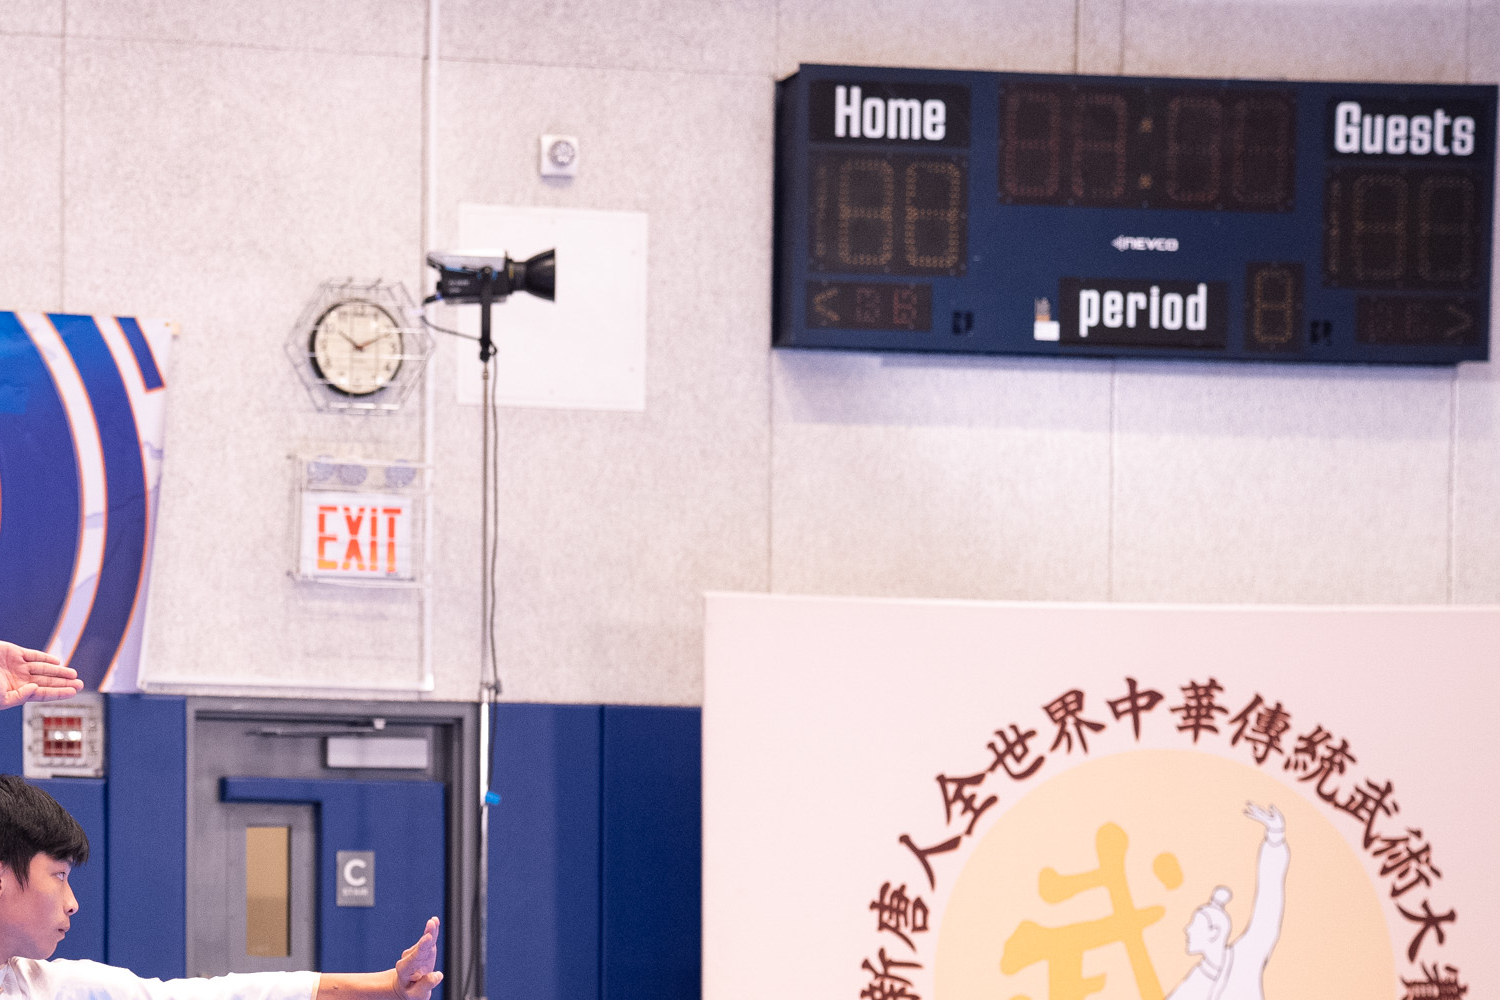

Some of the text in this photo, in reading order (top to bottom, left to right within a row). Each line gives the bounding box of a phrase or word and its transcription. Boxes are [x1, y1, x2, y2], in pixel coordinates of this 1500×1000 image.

[834, 85, 946, 141] Home
[1334, 101, 1476, 156] Guests
[1079, 282, 1208, 338] period
[317, 505, 402, 573] EXIT
[344, 858, 367, 887] C
